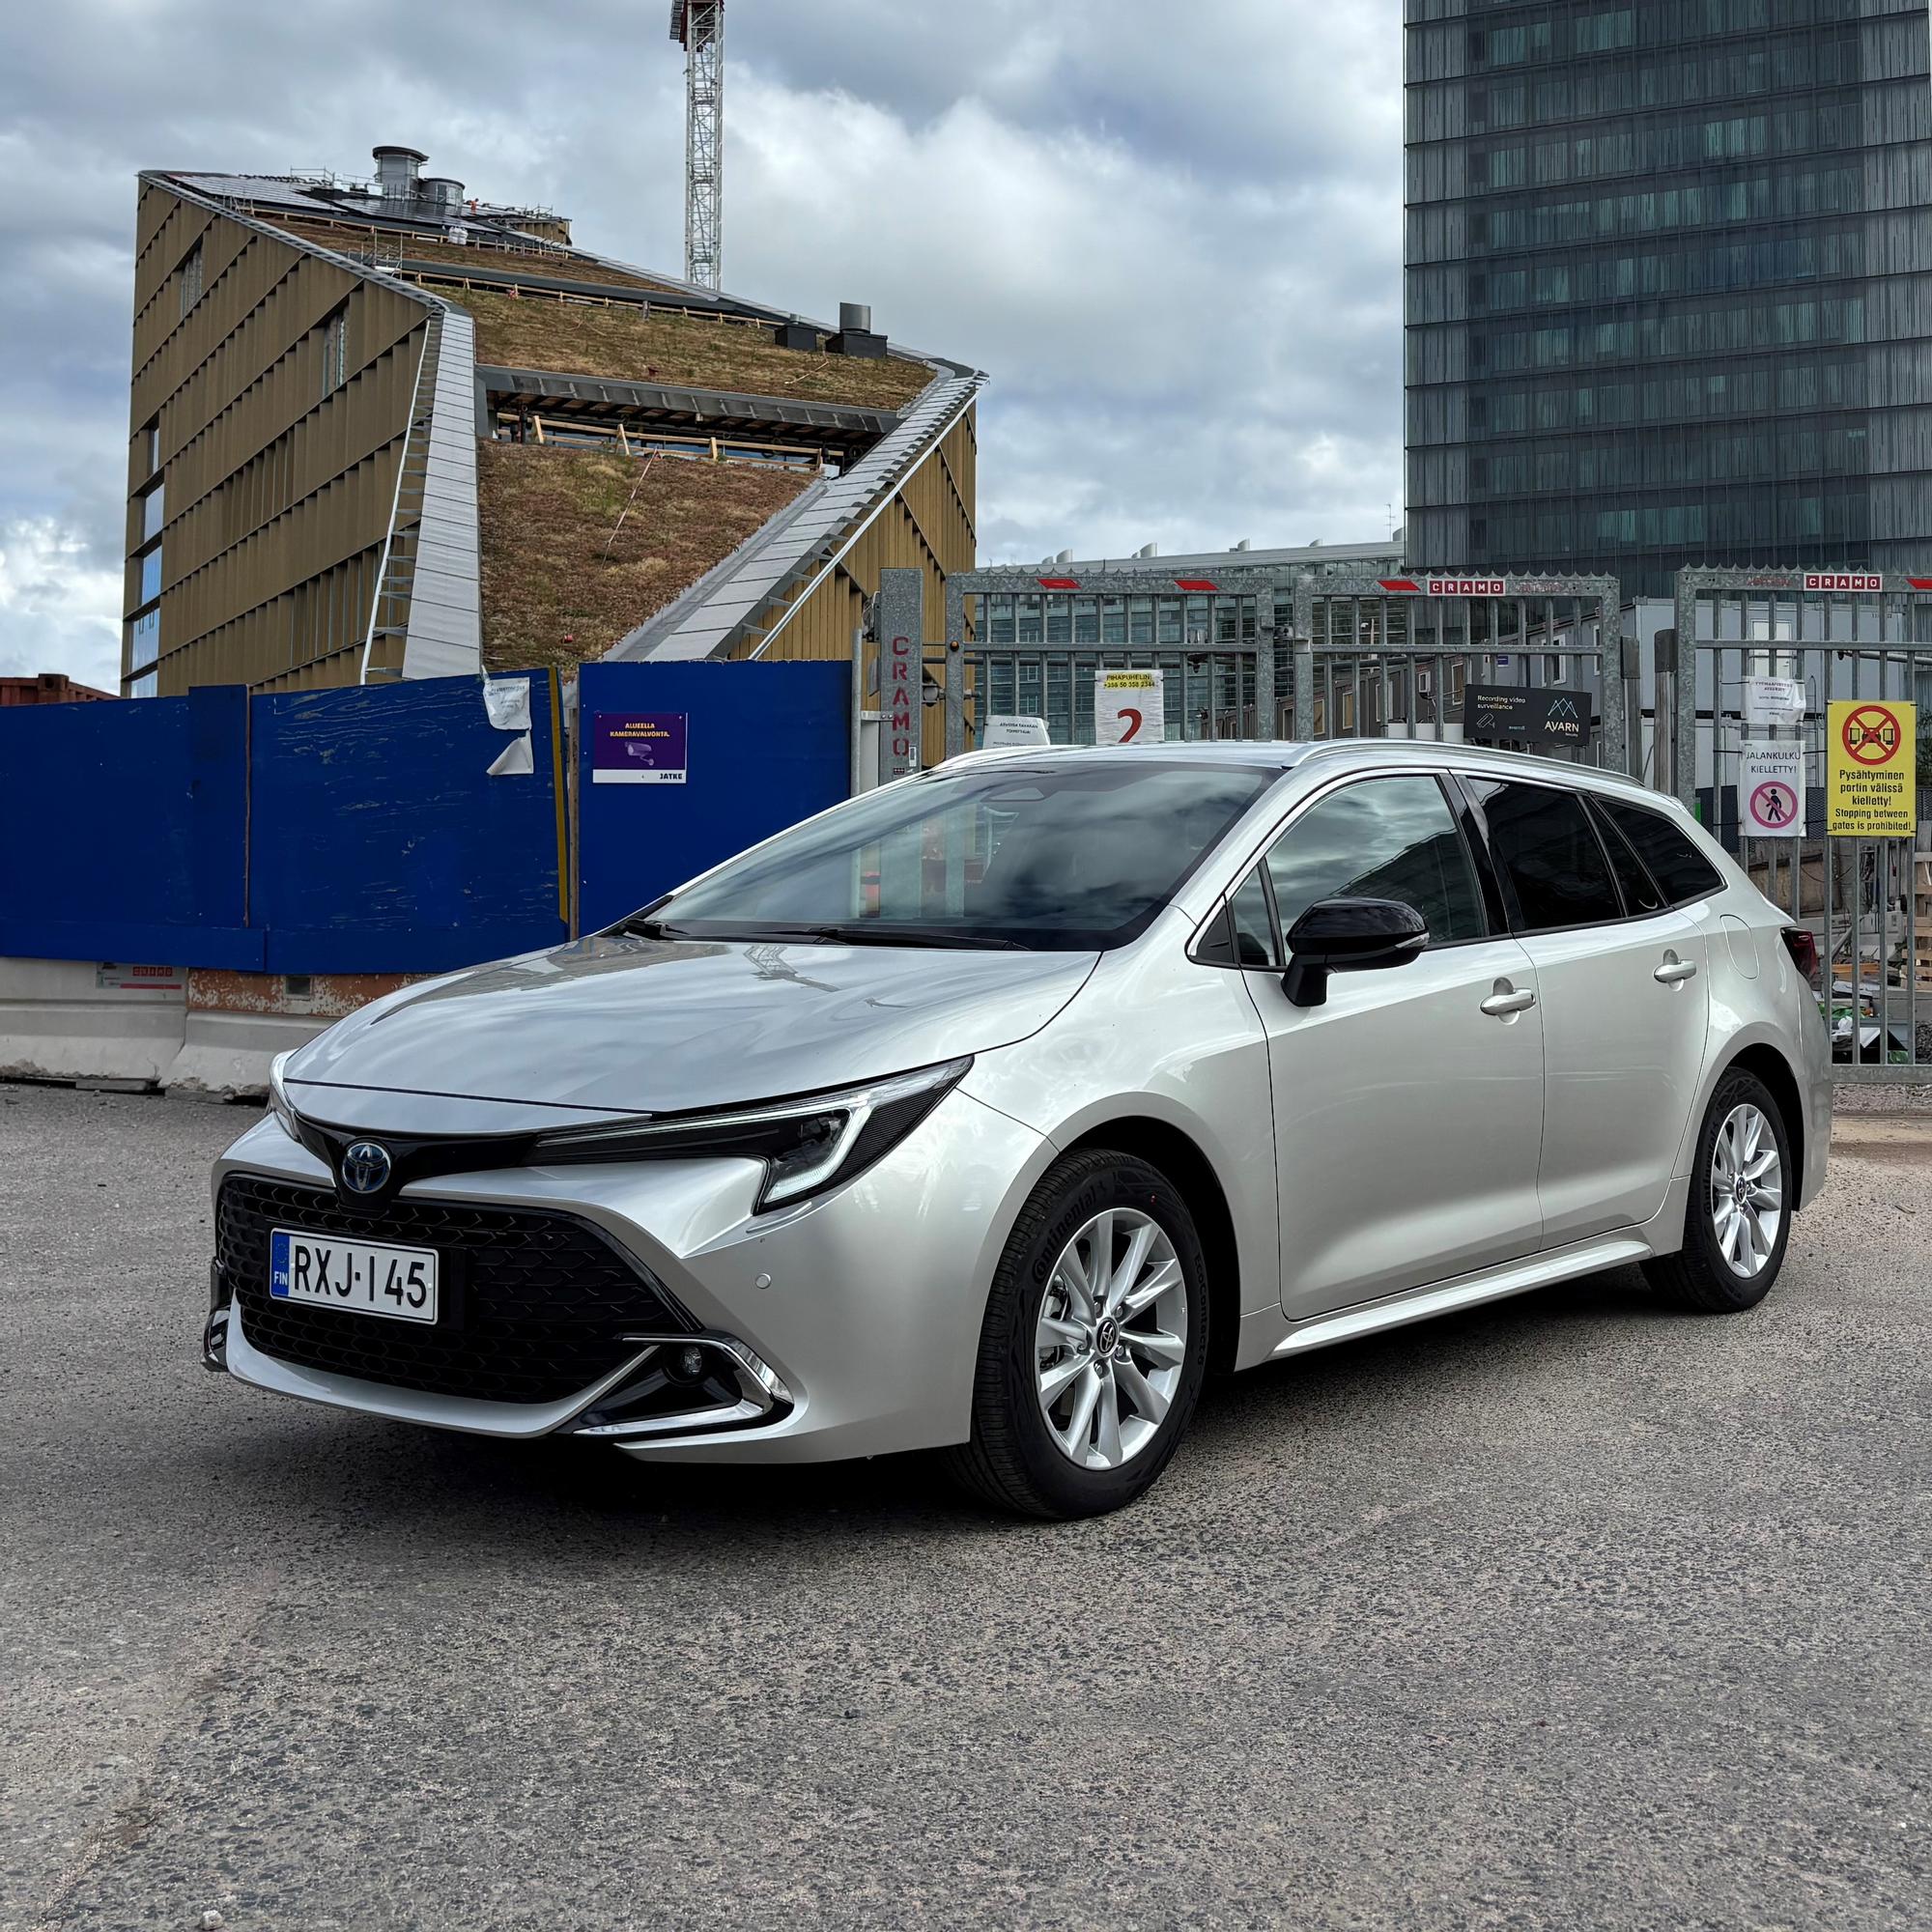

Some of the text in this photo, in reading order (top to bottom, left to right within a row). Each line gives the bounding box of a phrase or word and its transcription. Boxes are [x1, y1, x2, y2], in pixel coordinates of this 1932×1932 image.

[1432, 582, 1501, 592] CRAMO
[1808, 577, 1877, 588] CRAMO
[892, 636, 909, 756] CRAMO
[1477, 695, 1508, 703] Recording
[1118, 708, 1142, 743] 2
[1545, 721, 1579, 732] AVARN
[1747, 752, 1801, 760] JALANKULKU
[1750, 765, 1797, 774] KIELLETTY!
[1839, 770, 1904, 781] Pysähtyminen
[1840, 782, 1903, 793] portin välissä
[1852, 796, 1891, 807] kielletty!
[1835, 809, 1908, 819] Stopping between
[1833, 821, 1911, 831] gates is prohibited!
[1033, 1185, 1096, 1285] Continental
[273, 1271, 288, 1286] FIN
[294, 1244, 427, 1309] RXJ-145
